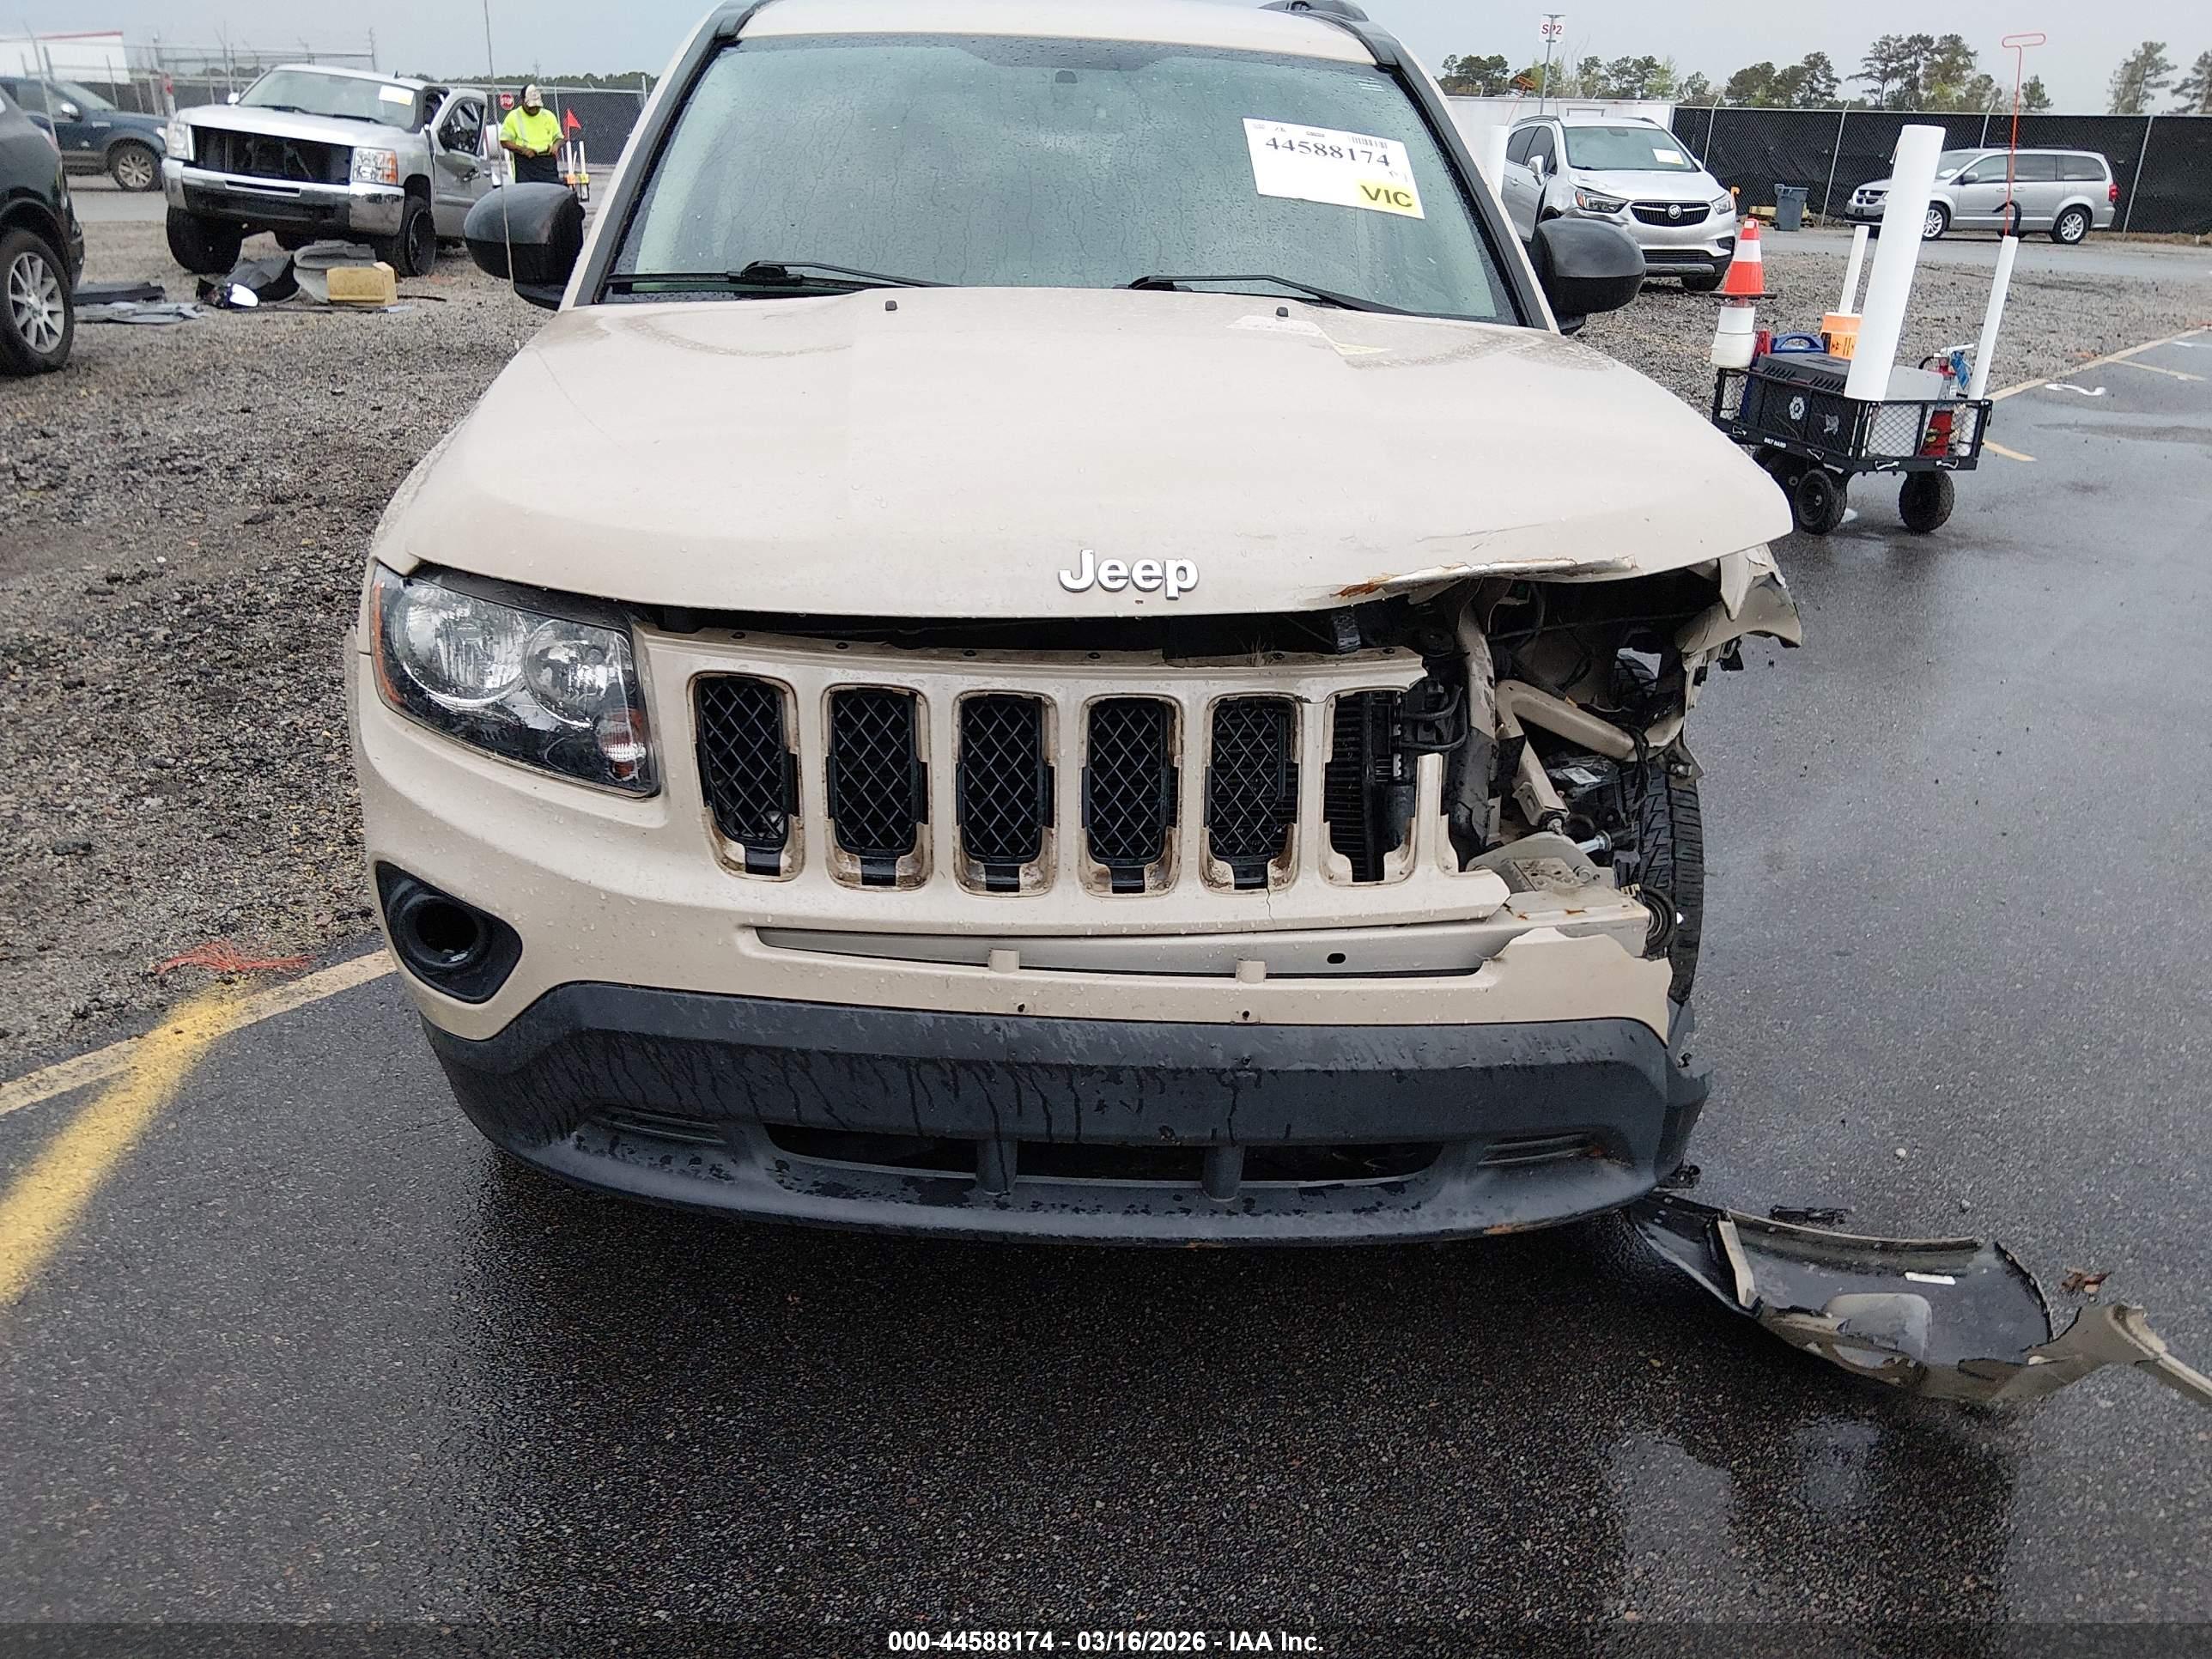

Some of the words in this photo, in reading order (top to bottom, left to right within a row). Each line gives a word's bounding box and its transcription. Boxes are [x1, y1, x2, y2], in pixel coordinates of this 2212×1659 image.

[1265, 137, 1390, 167] 44588174
[1360, 185, 1413, 208] VIC
[1058, 549, 1199, 600] Jeep
